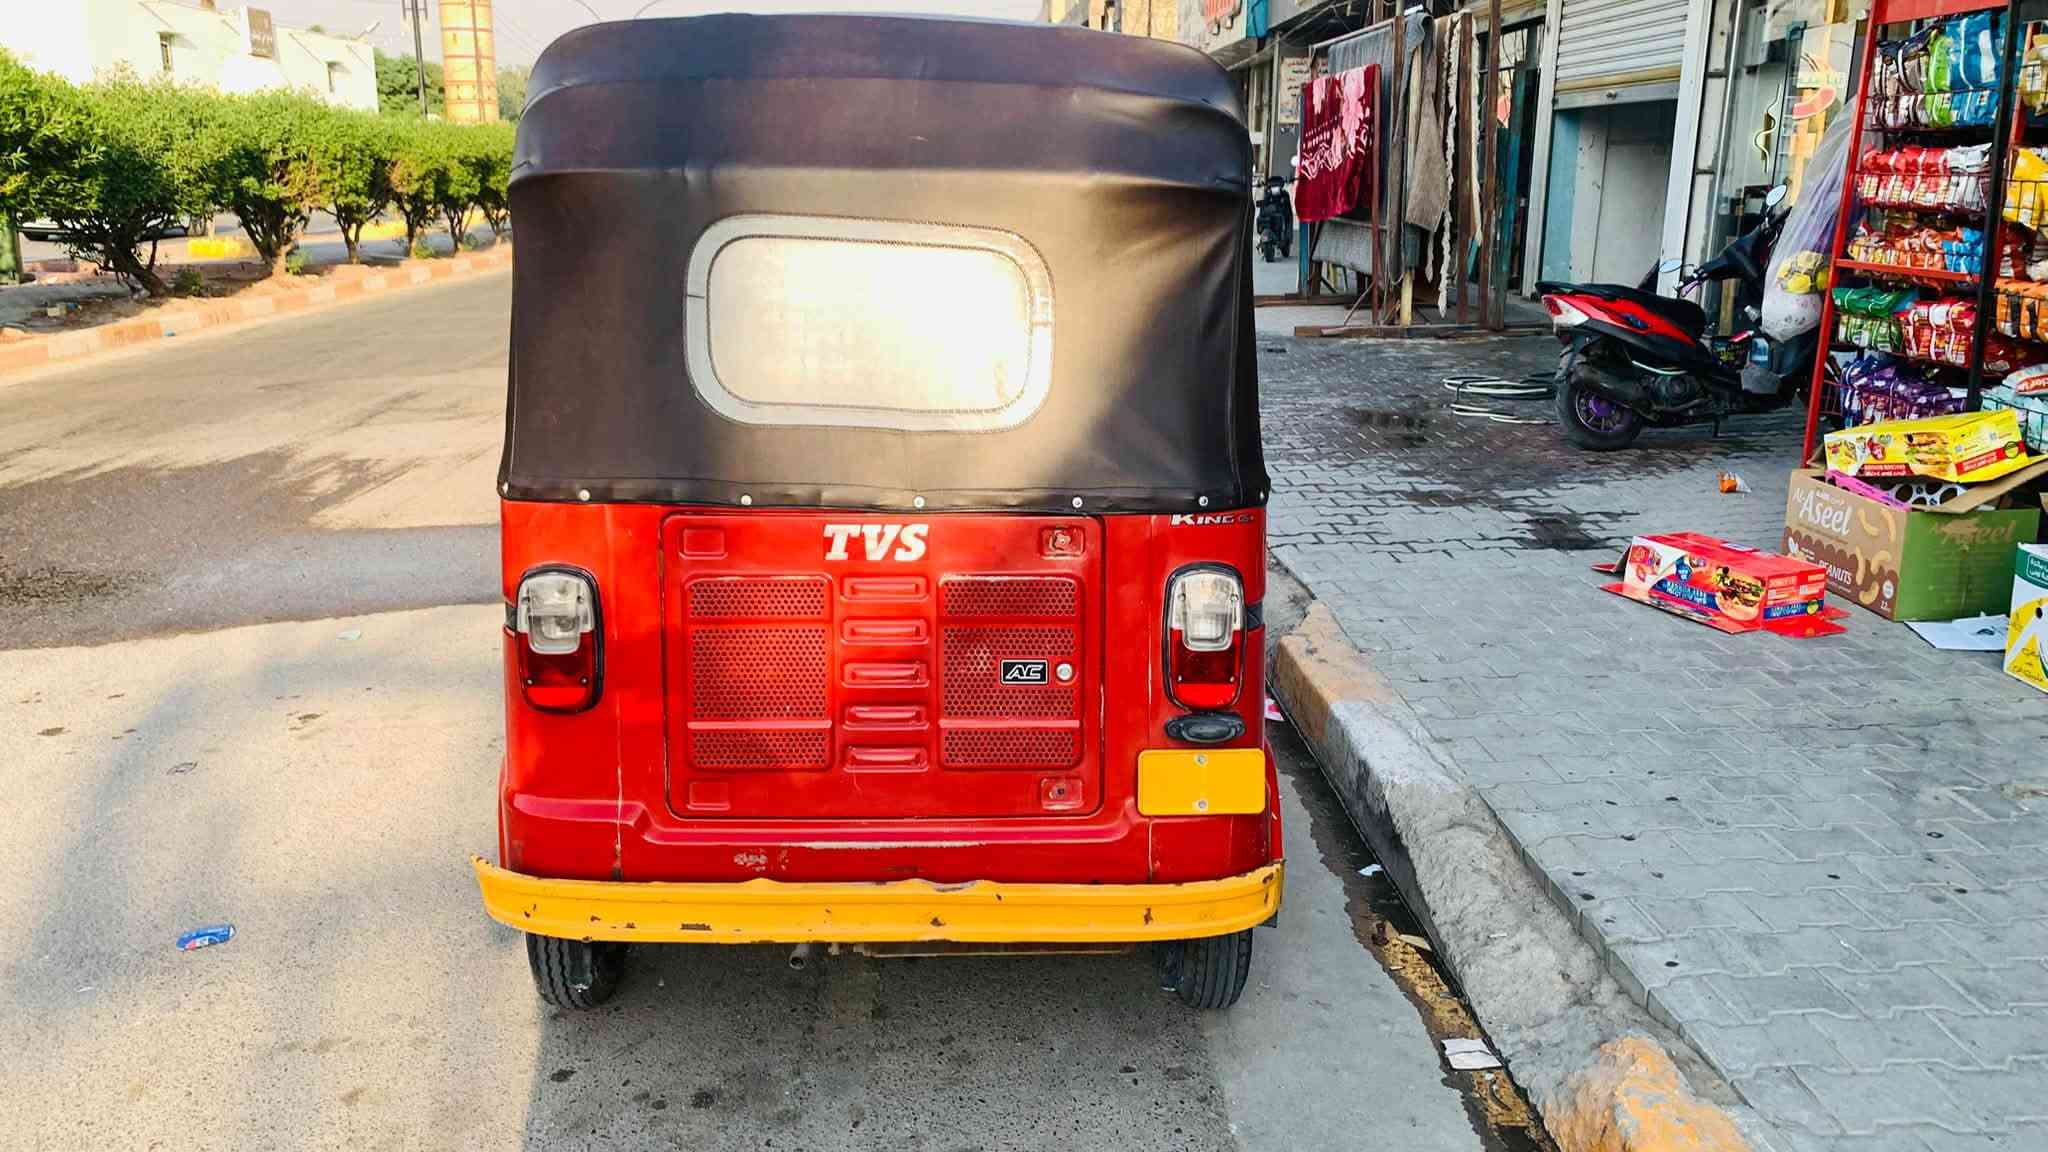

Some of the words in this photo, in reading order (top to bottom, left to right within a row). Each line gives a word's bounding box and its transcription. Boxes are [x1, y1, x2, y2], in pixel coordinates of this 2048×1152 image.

[1799, 490, 1853, 536] Aseel
[823, 524, 929, 561] TVS
[1005, 664, 1044, 679] AC
